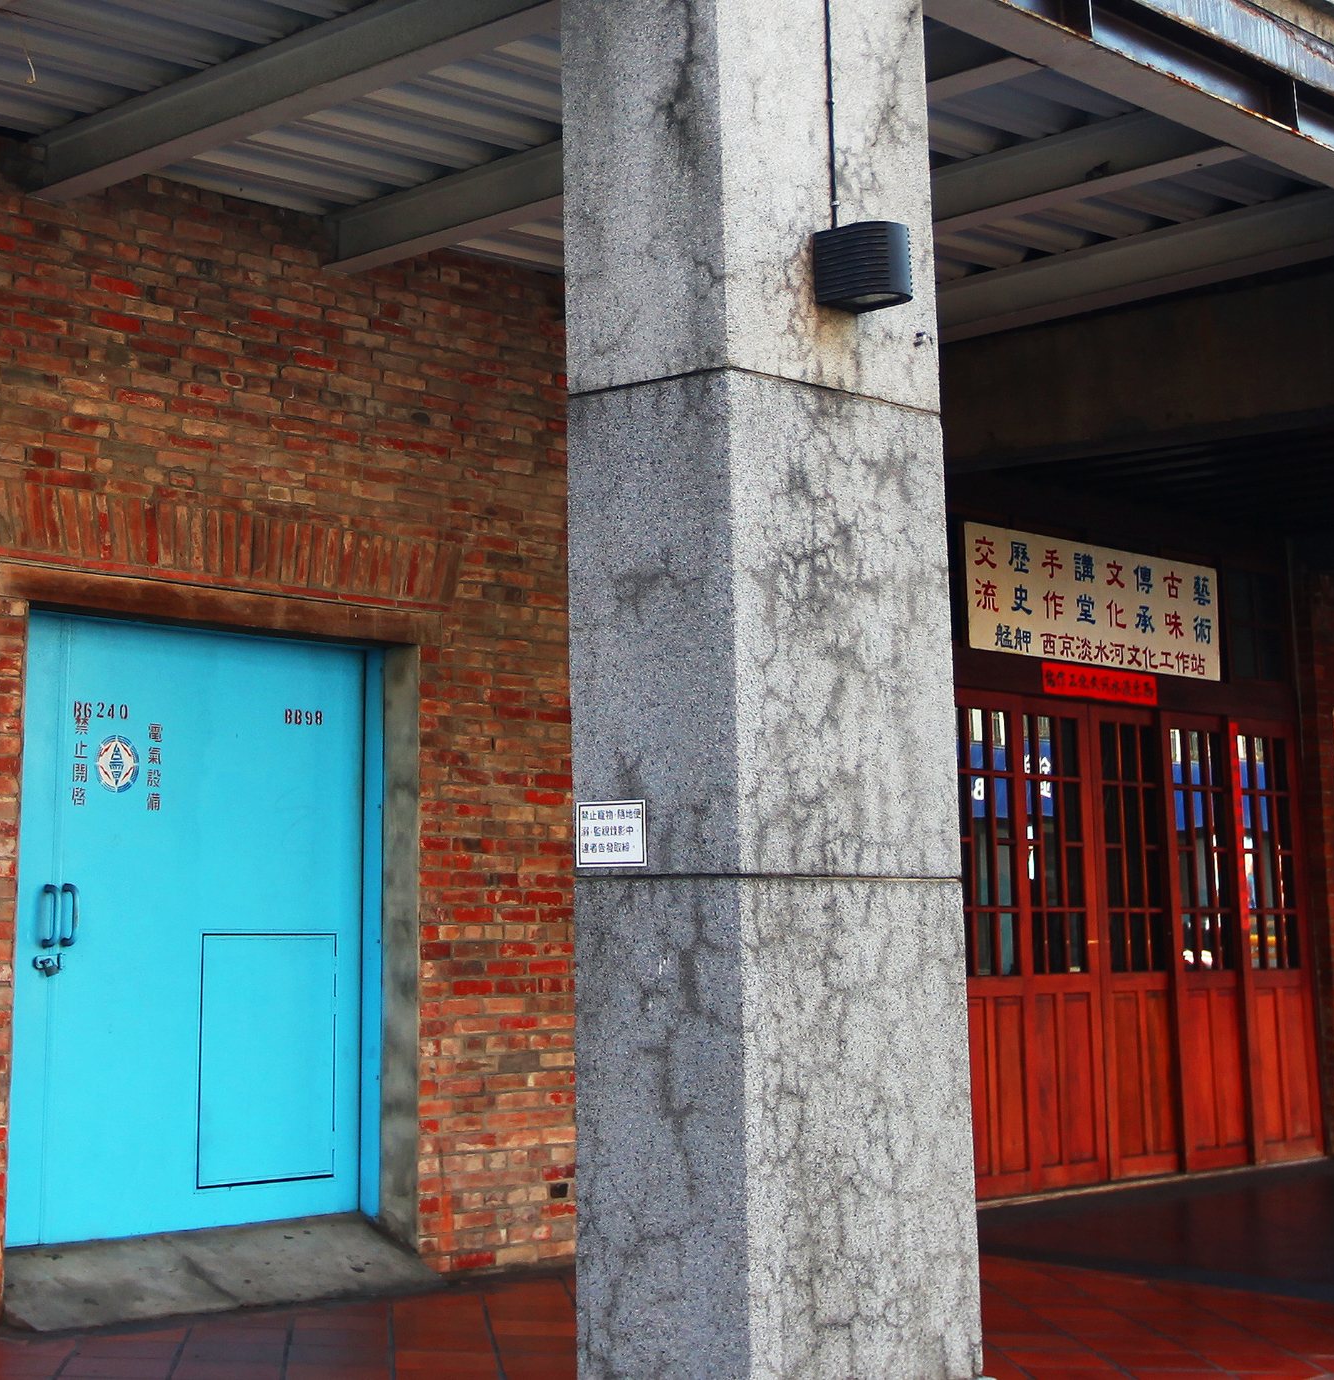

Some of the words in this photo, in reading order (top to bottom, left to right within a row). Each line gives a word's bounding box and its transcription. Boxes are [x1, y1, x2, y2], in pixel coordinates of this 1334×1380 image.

[1040, 633, 1206, 676] 西京淡水河文化工作站
[74, 700, 129, 720] B6240
[146, 722, 164, 812] 電氣設備
